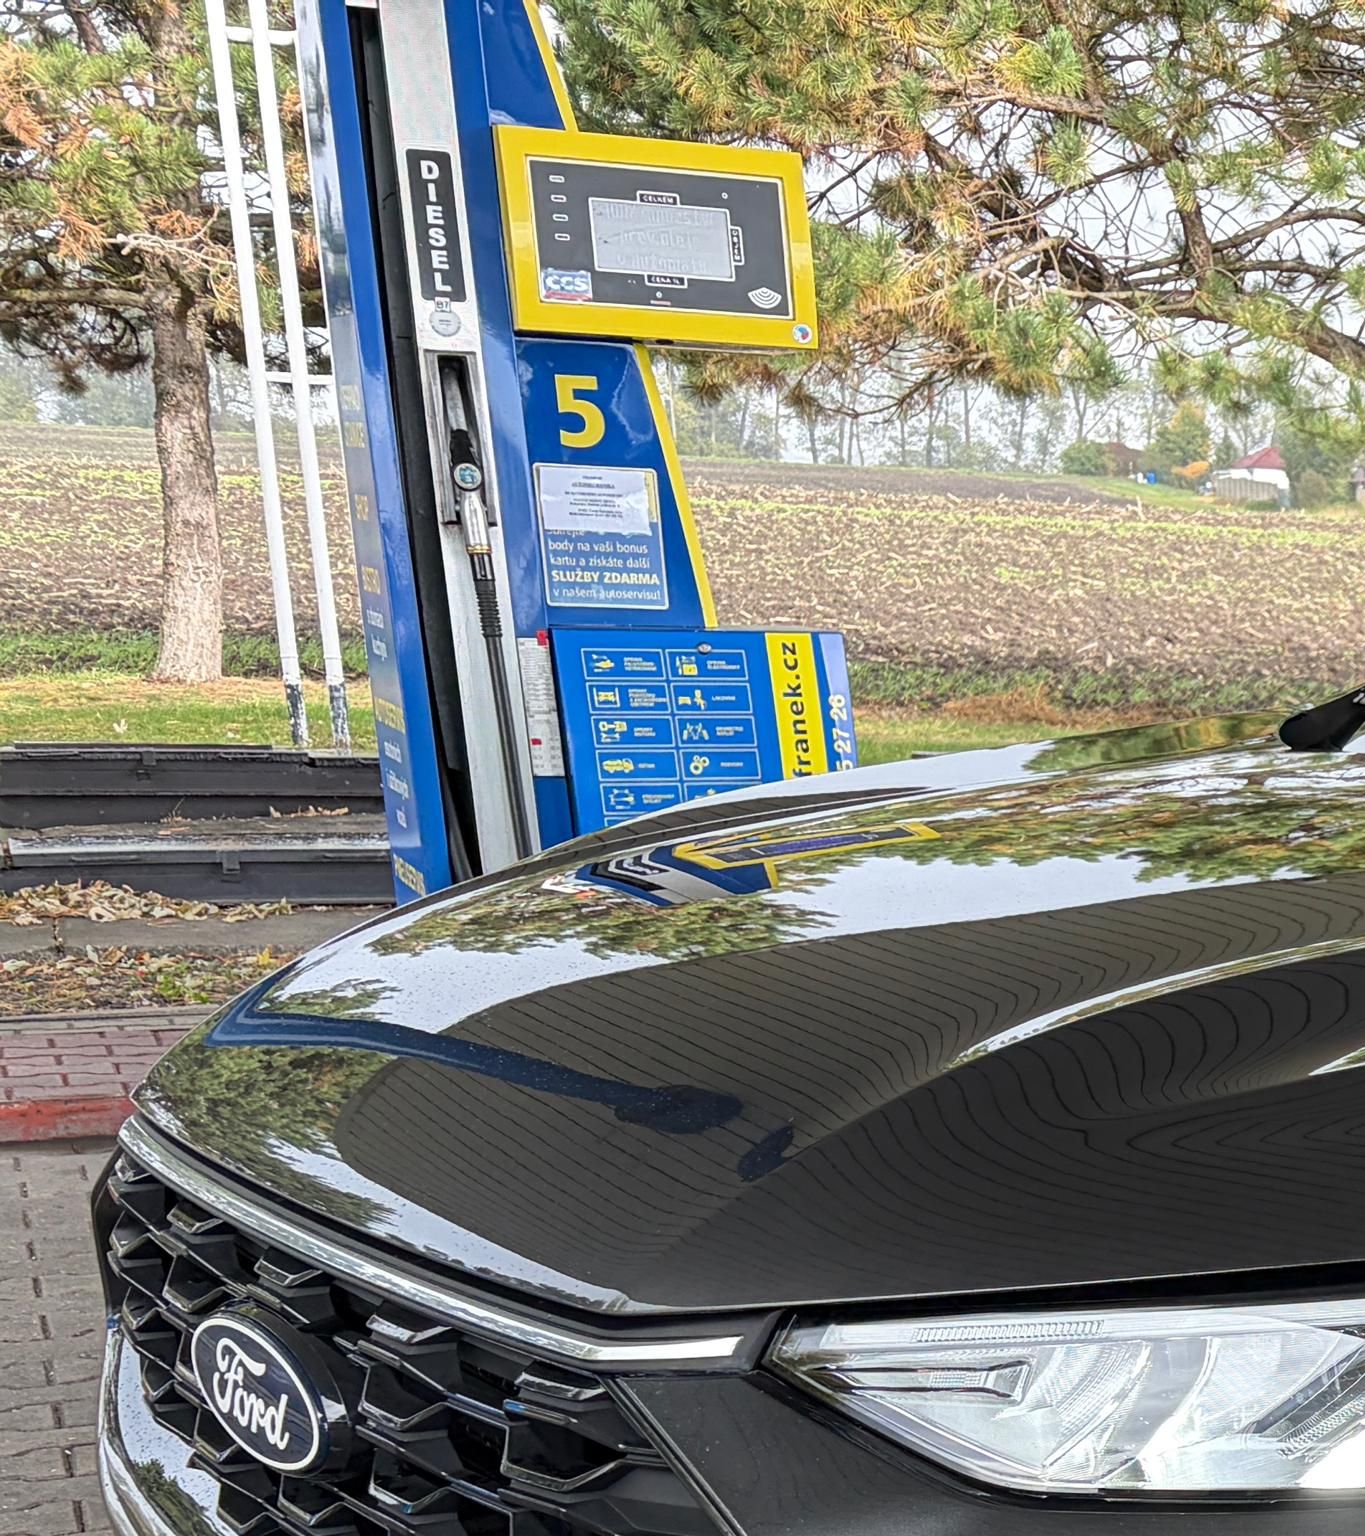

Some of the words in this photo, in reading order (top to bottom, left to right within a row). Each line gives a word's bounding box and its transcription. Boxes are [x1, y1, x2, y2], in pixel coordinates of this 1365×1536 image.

[420, 160, 452, 292] DIESEL
[545, 275, 589, 291] CCS
[554, 374, 606, 449] 5
[548, 538, 574, 553] body
[577, 542, 590, 551] na
[593, 540, 614, 552] vaši
[616, 541, 648, 554] bonus
[550, 554, 576, 566] kartu
[579, 558, 586, 566] a
[589, 555, 624, 568] získáte
[626, 556, 650, 569] další
[551, 567, 599, 583] SLUŽBY
[603, 571, 660, 585] ZDARMA
[553, 588, 560, 596] v
[563, 586, 597, 598] našem
[600, 587, 661, 600] autoservisu!
[782, 642, 812, 778] franek.cz
[833, 727, 851, 754] 27
[213, 1337, 290, 1450] Ford
